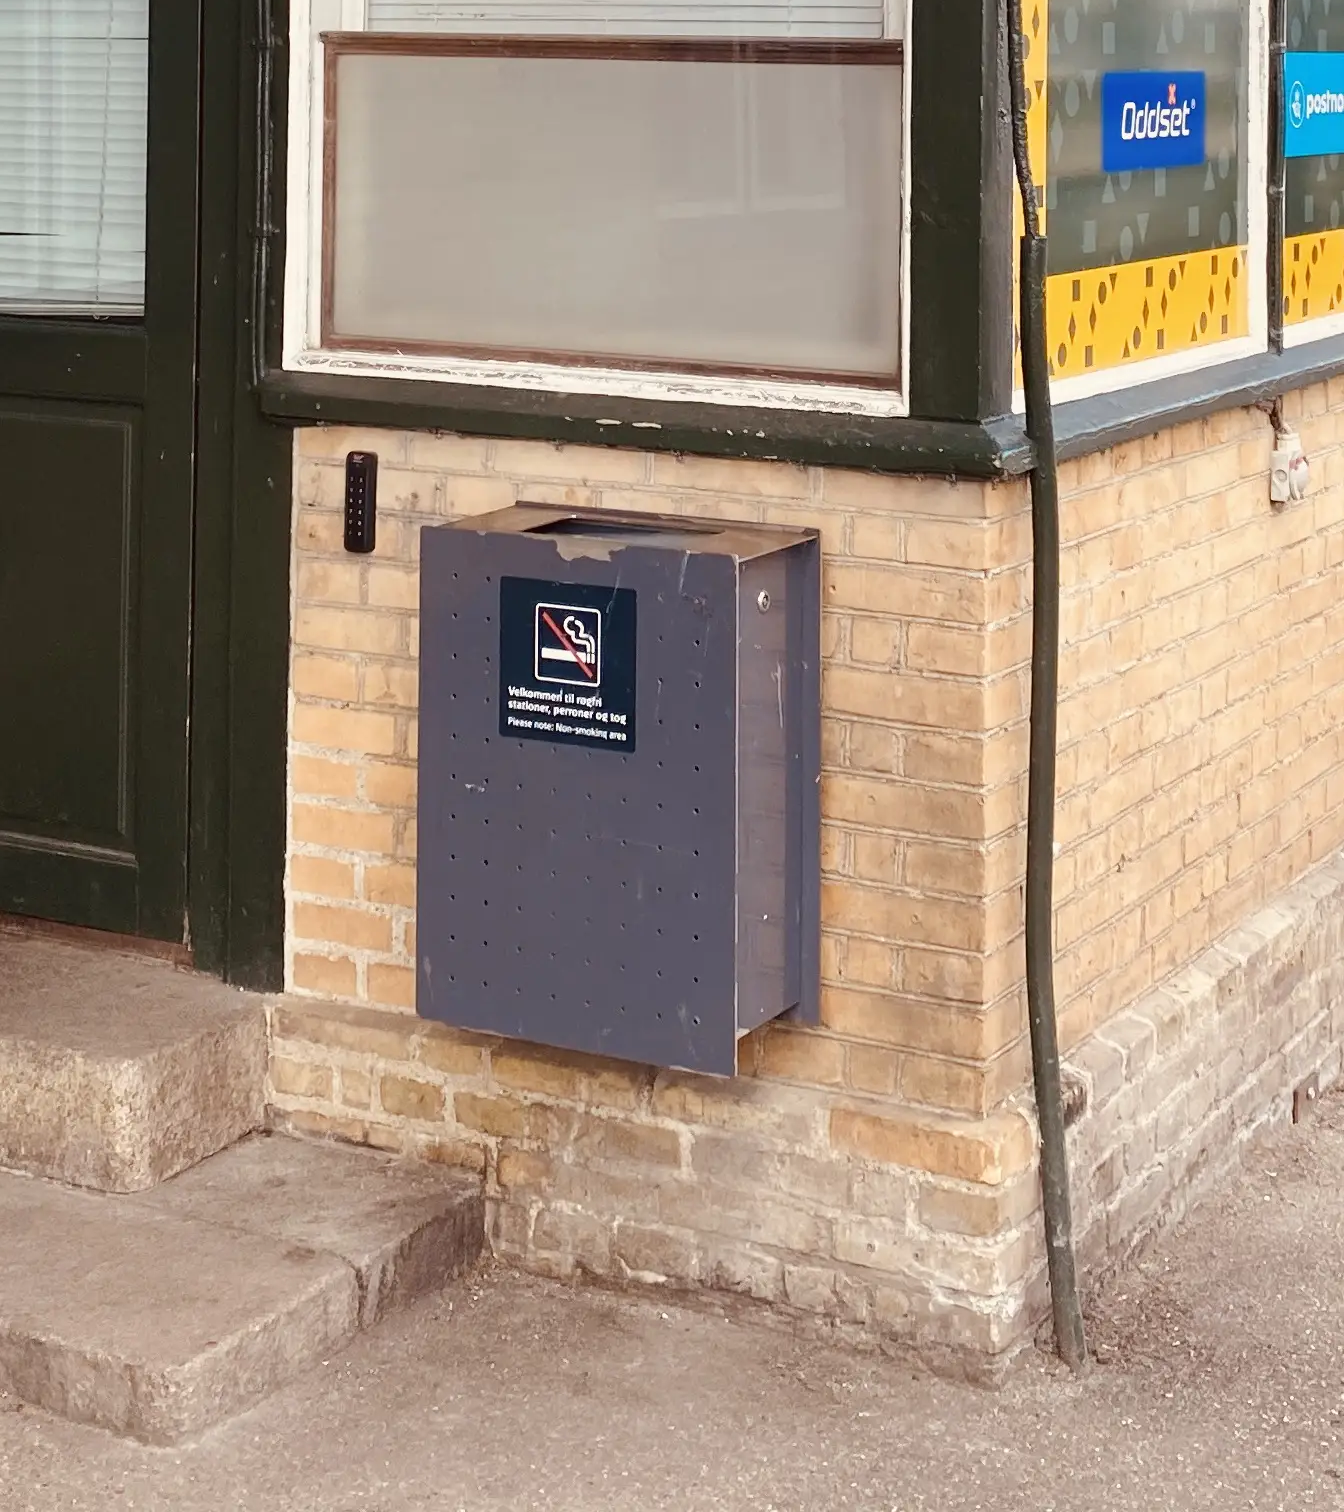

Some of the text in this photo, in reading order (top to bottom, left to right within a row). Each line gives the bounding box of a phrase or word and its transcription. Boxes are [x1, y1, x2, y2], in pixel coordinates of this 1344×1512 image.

[1121, 99, 1190, 141] Oddset
[508, 686, 563, 702] Velkommen
[564, 693, 575, 704] til
[508, 700, 627, 725] stationer, perroner og tog
[508, 716, 627, 741] Please note: Non-smoking area
